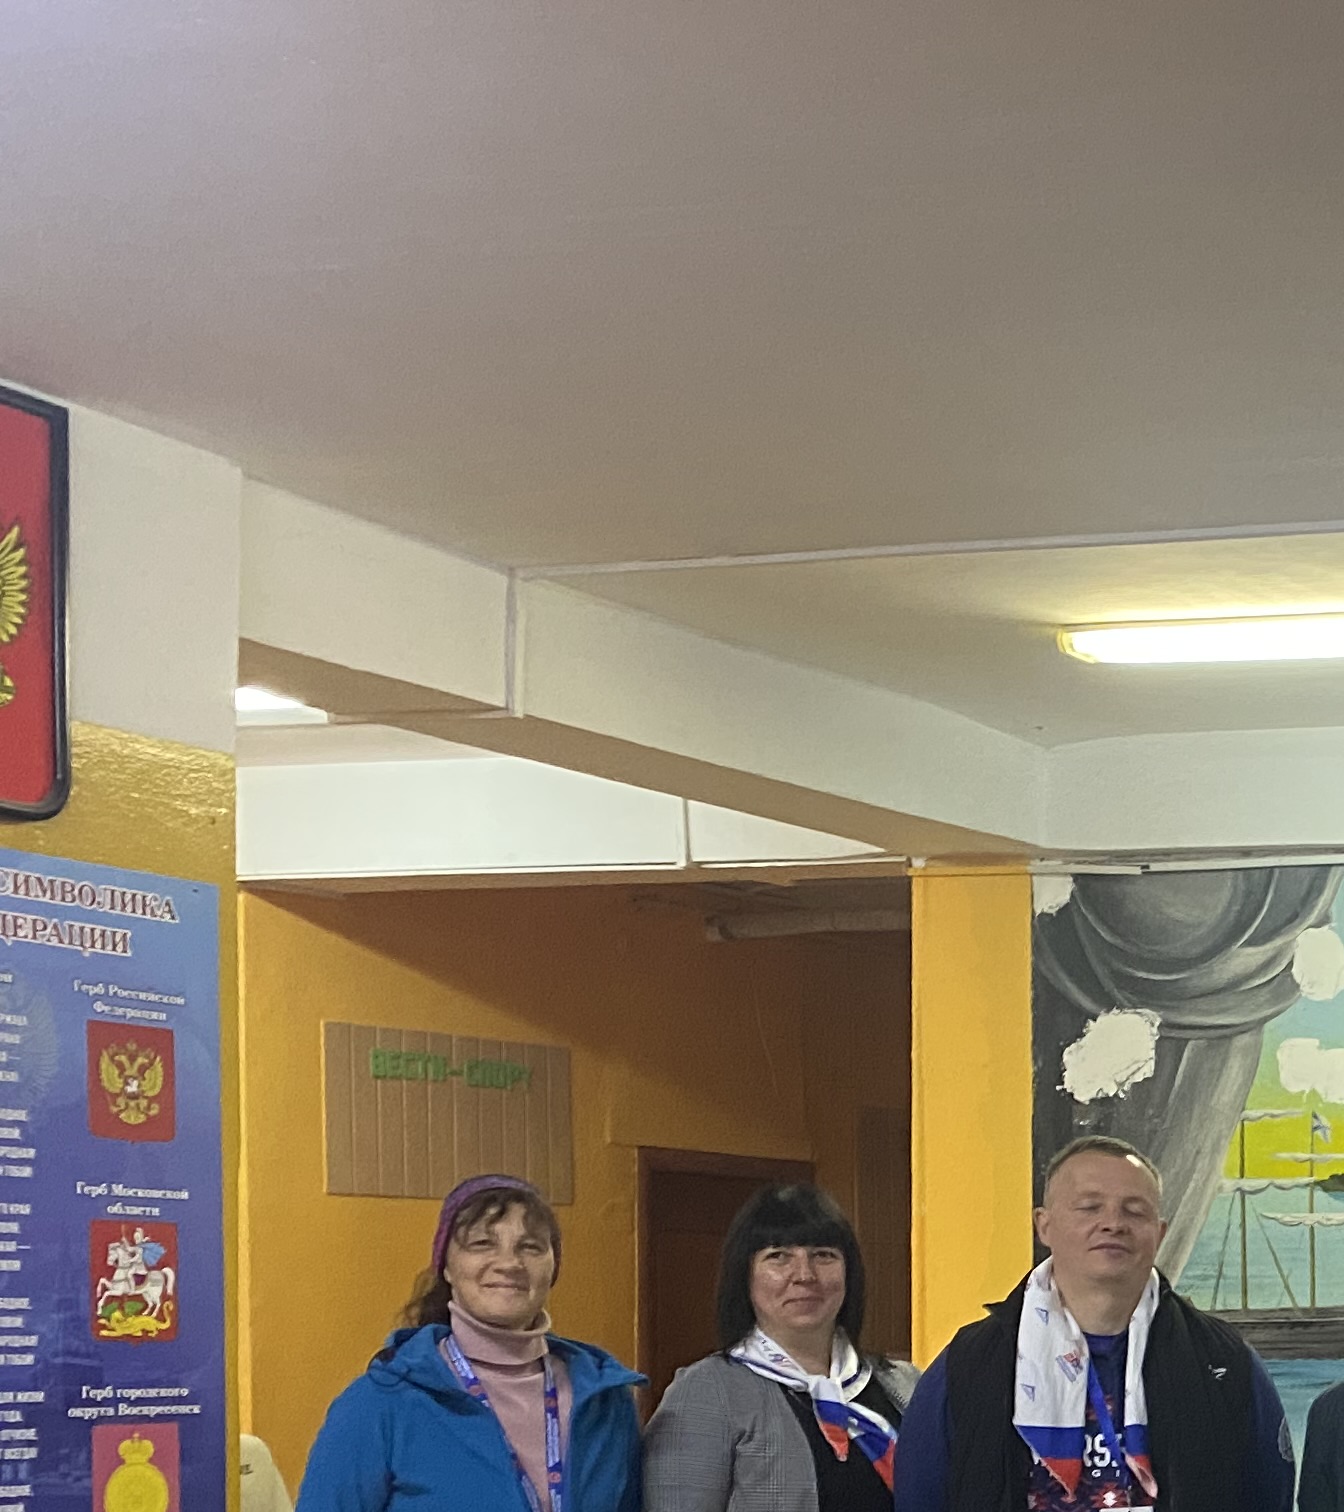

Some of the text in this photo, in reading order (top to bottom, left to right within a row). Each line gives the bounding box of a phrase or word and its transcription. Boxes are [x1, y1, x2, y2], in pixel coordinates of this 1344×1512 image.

[73, 979, 186, 1005] Герб Российской
[76, 1181, 190, 1200] Герб Московской
[106, 1202, 161, 1216] области
[81, 1385, 114, 1401] Герб
